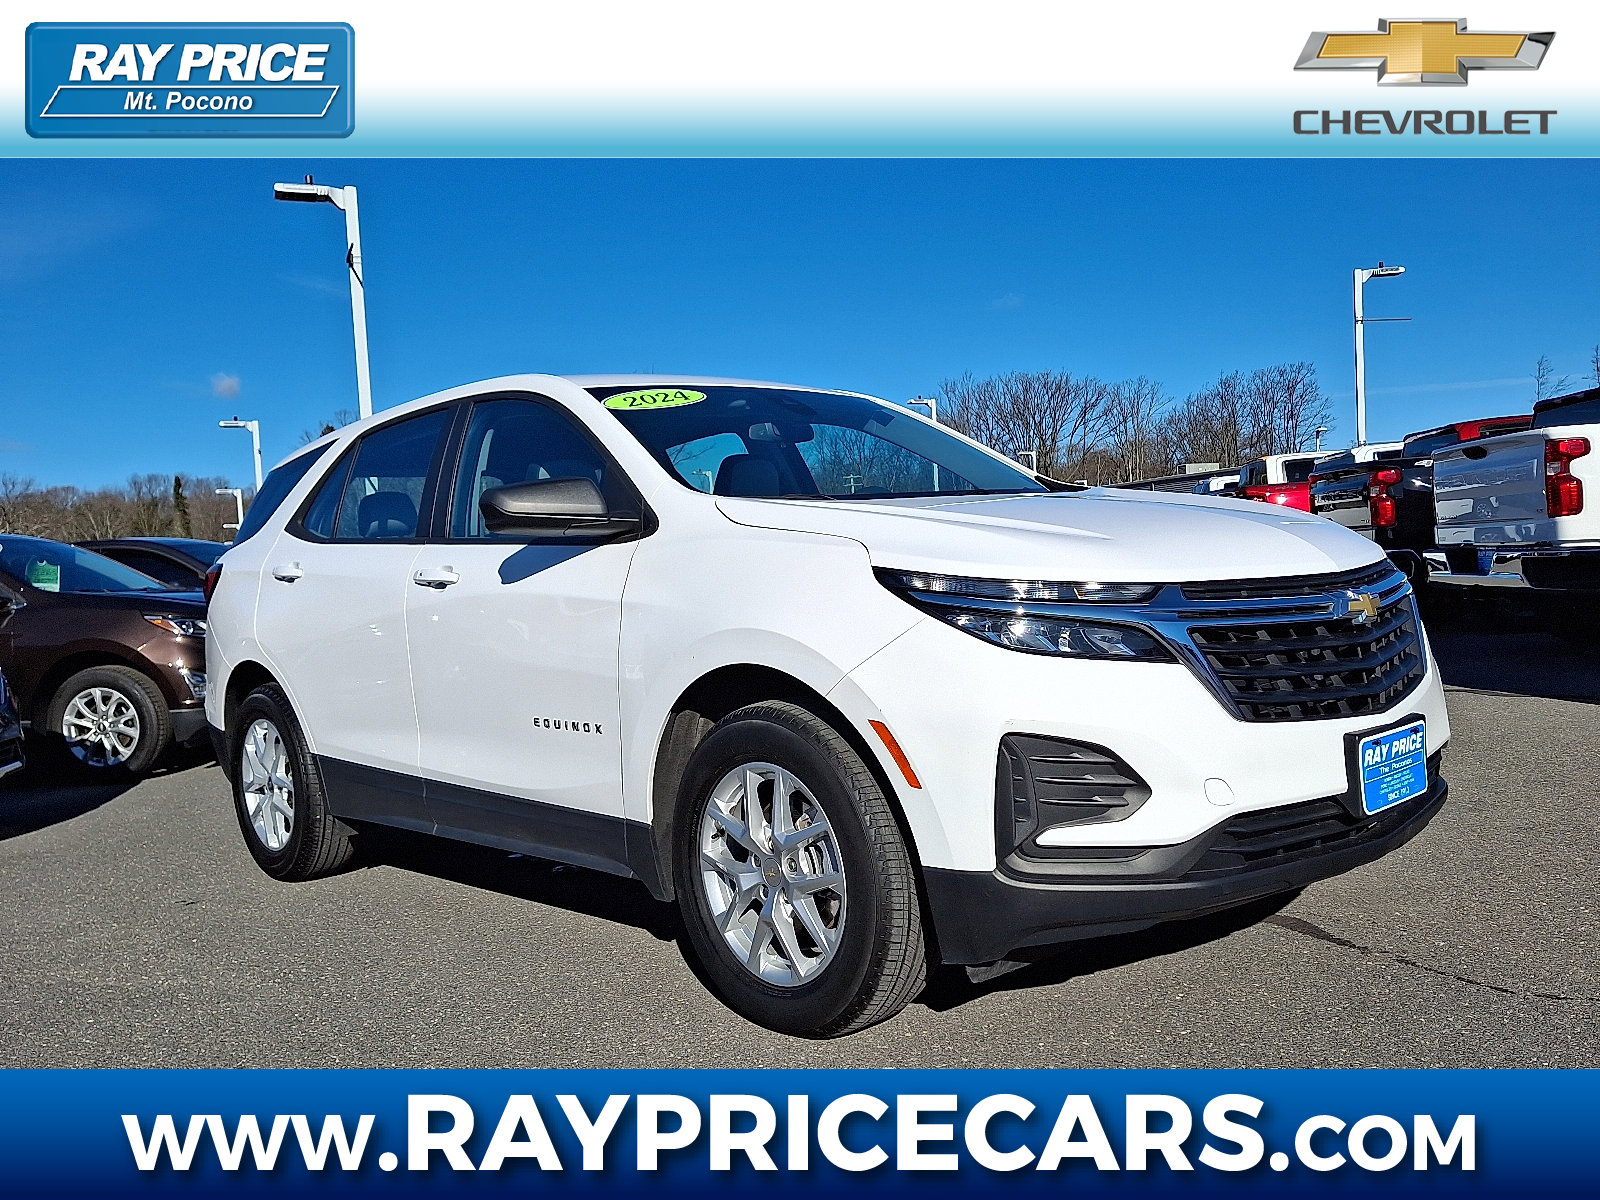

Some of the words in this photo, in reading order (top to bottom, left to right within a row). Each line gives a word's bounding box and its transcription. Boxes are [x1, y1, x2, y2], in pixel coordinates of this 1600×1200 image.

[623, 391, 690, 407] 2024
[533, 717, 603, 735] EQUINOX
[1364, 743, 1390, 768] RAY
[1392, 732, 1424, 758] PRICE
[1379, 766, 1390, 775] The
